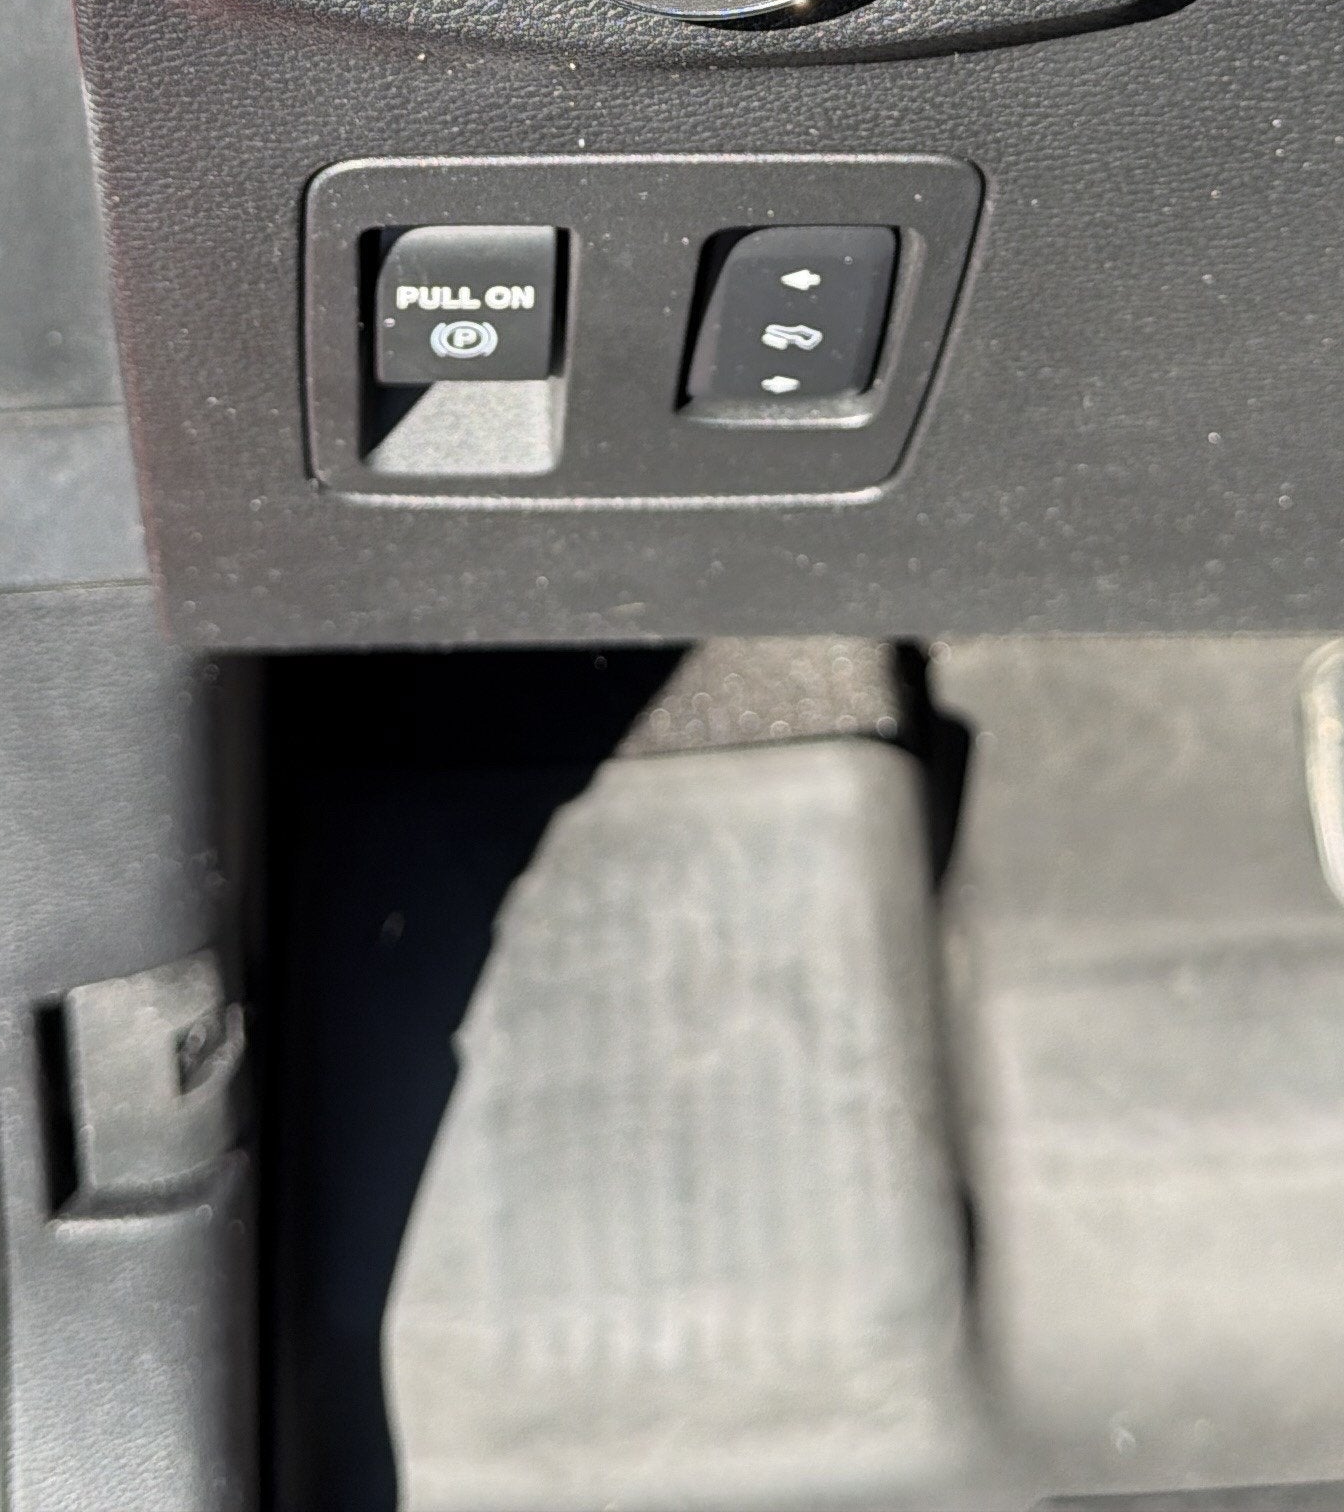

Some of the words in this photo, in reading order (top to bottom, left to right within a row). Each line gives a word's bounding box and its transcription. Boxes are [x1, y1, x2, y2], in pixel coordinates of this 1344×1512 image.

[396, 285, 482, 310] PULL
[484, 285, 535, 310] ON
[453, 328, 477, 348] P
